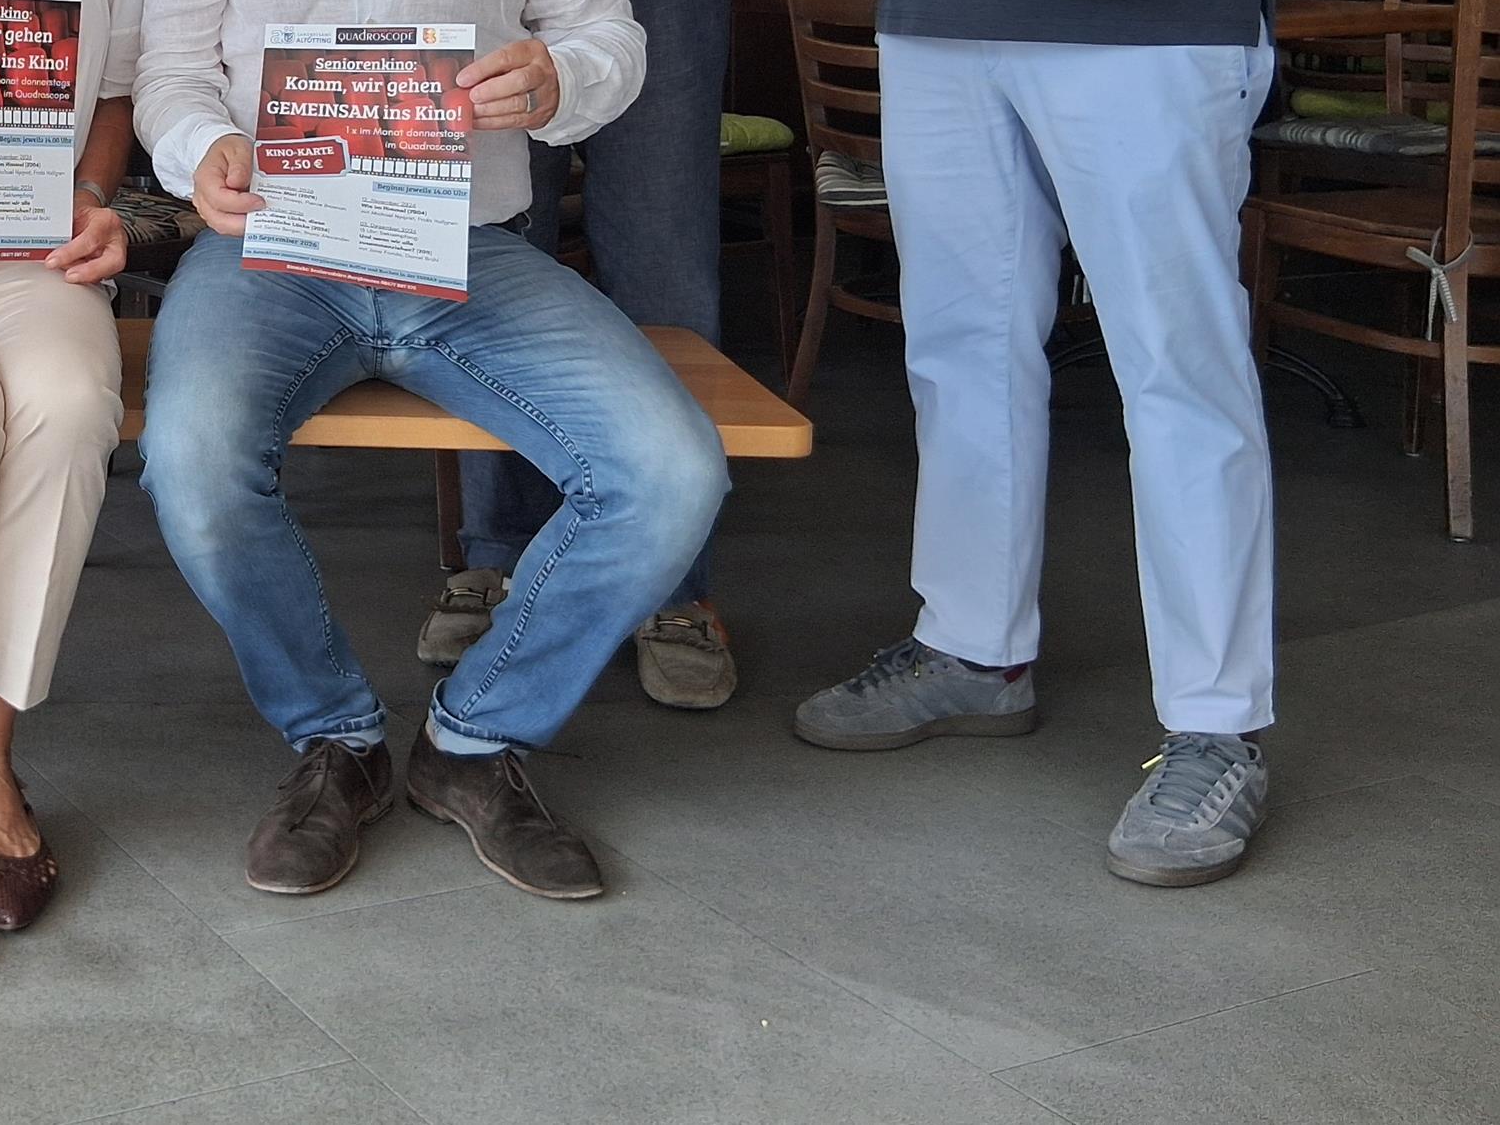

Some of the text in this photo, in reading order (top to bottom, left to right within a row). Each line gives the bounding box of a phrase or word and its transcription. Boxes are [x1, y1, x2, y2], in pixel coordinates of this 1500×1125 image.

[5, 27, 53, 45] gehen
[2, 54, 25, 69] ins
[29, 55, 68, 71] Kino!
[315, 57, 417, 72] Seniorenkino:
[21, 77, 70, 88] donnerstags
[286, 77, 442, 96] Komm, wir gehen
[267, 101, 462, 122] GEMEINSAM ins Kino!
[266, 146, 334, 156] KINO-KARTE
[282, 159, 323, 170] 2,50 €
